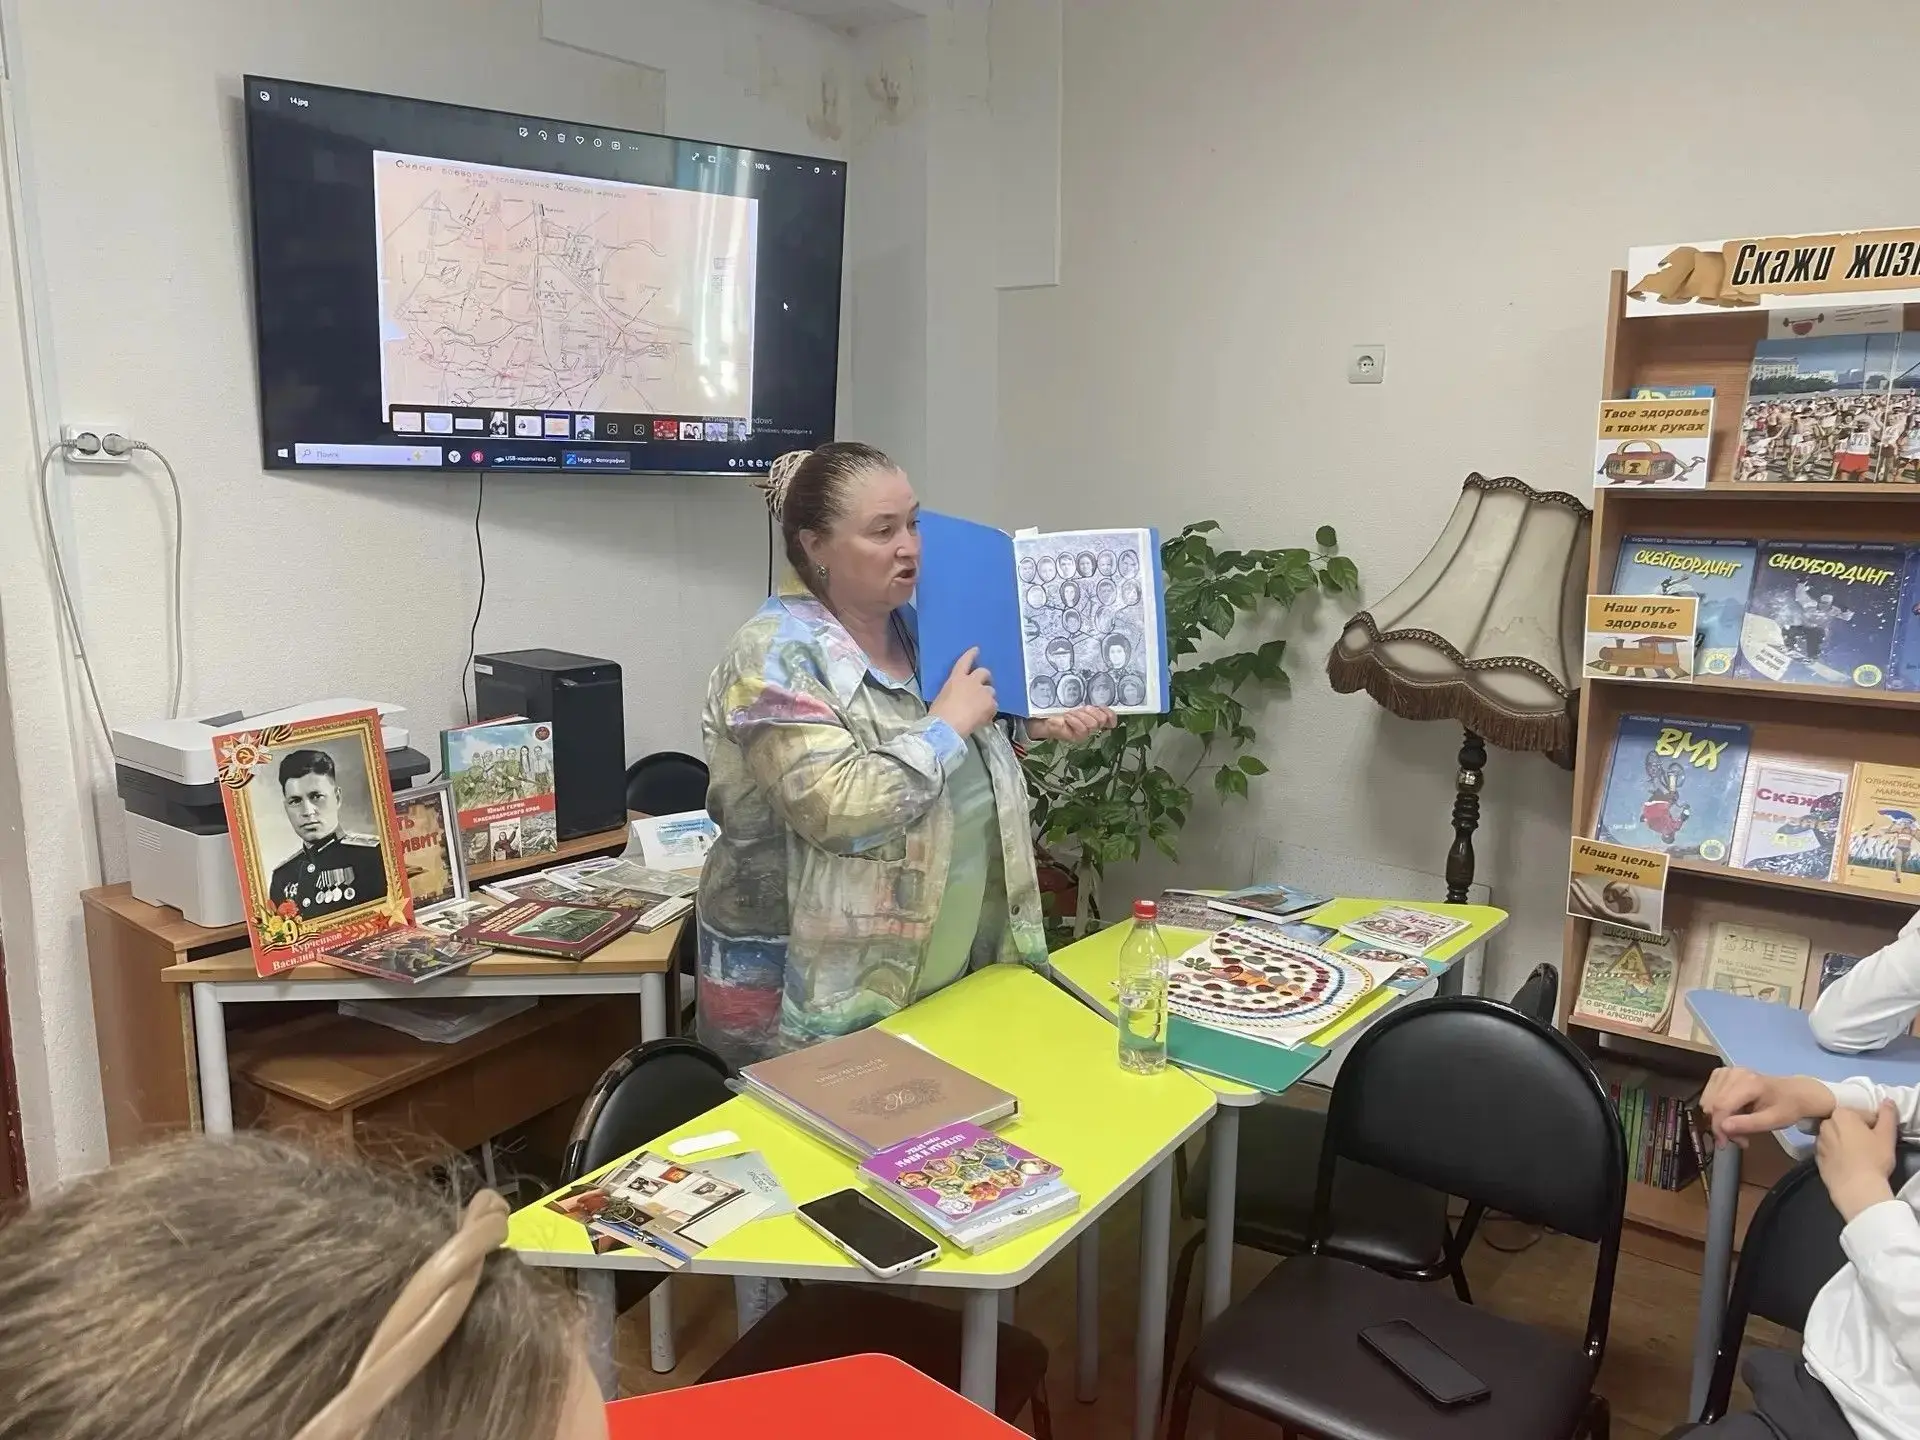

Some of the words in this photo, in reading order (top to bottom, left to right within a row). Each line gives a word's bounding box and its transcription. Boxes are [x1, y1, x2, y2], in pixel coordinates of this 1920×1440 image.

[290, 97, 308, 107] 14.jpg
[755, 162, 764, 170] 100
[1731, 244, 1836, 286] Скажи
[1603, 408, 1637, 419] Твое
[1639, 408, 1710, 420] здоровье
[1604, 424, 1614, 433] в
[1616, 423, 1657, 433] твоих
[1659, 422, 1706, 434] руках
[316, 450, 339, 460] Поиск
[1632, 549, 1743, 579] СКЕЙТБОРДИНГ
[1768, 552, 1895, 585] СНОУБОРДИНГ
[1603, 602, 1638, 613] Наш
[1641, 605, 1681, 616] путь-
[1604, 619, 1678, 631] здоровье
[1655, 727, 1729, 771] BMX
[1579, 844, 1618, 861] Наша
[1621, 855, 1661, 869] цель-
[1594, 863, 1640, 880] жизнь
[282, 919, 299, 944] 9
[291, 933, 343, 954] Курченков
[272, 952, 316, 971] Василий
[1593, 1001, 1618, 1011] ВРЕДЕ
[1620, 1007, 1656, 1019] НИКОТИНА
[1606, 1011, 1644, 1023] АЛКОГОЛЯ
